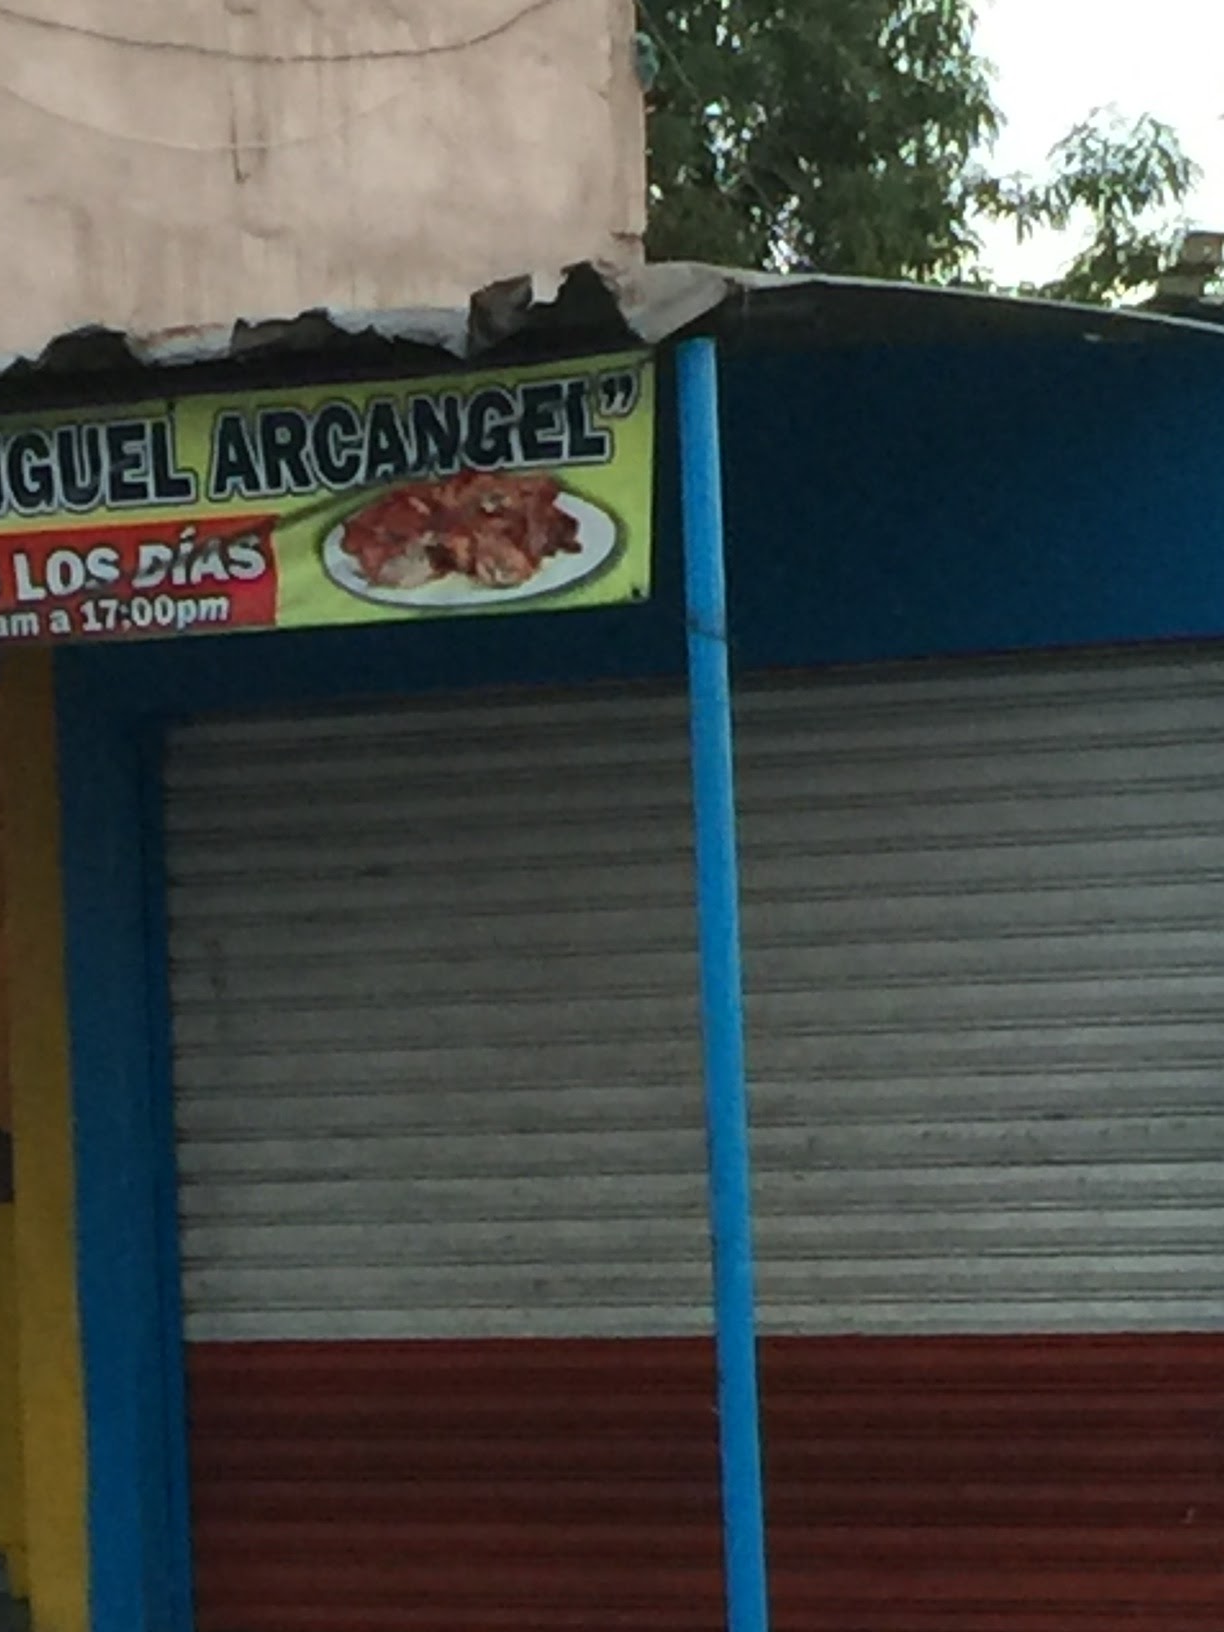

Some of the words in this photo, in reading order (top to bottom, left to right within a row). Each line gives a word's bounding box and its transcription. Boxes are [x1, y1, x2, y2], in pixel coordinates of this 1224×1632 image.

[13, 547, 120, 601] LOS
[132, 526, 266, 588] DÍAS
[49, 609, 72, 635] a
[80, 594, 230, 632] 17:00pm
